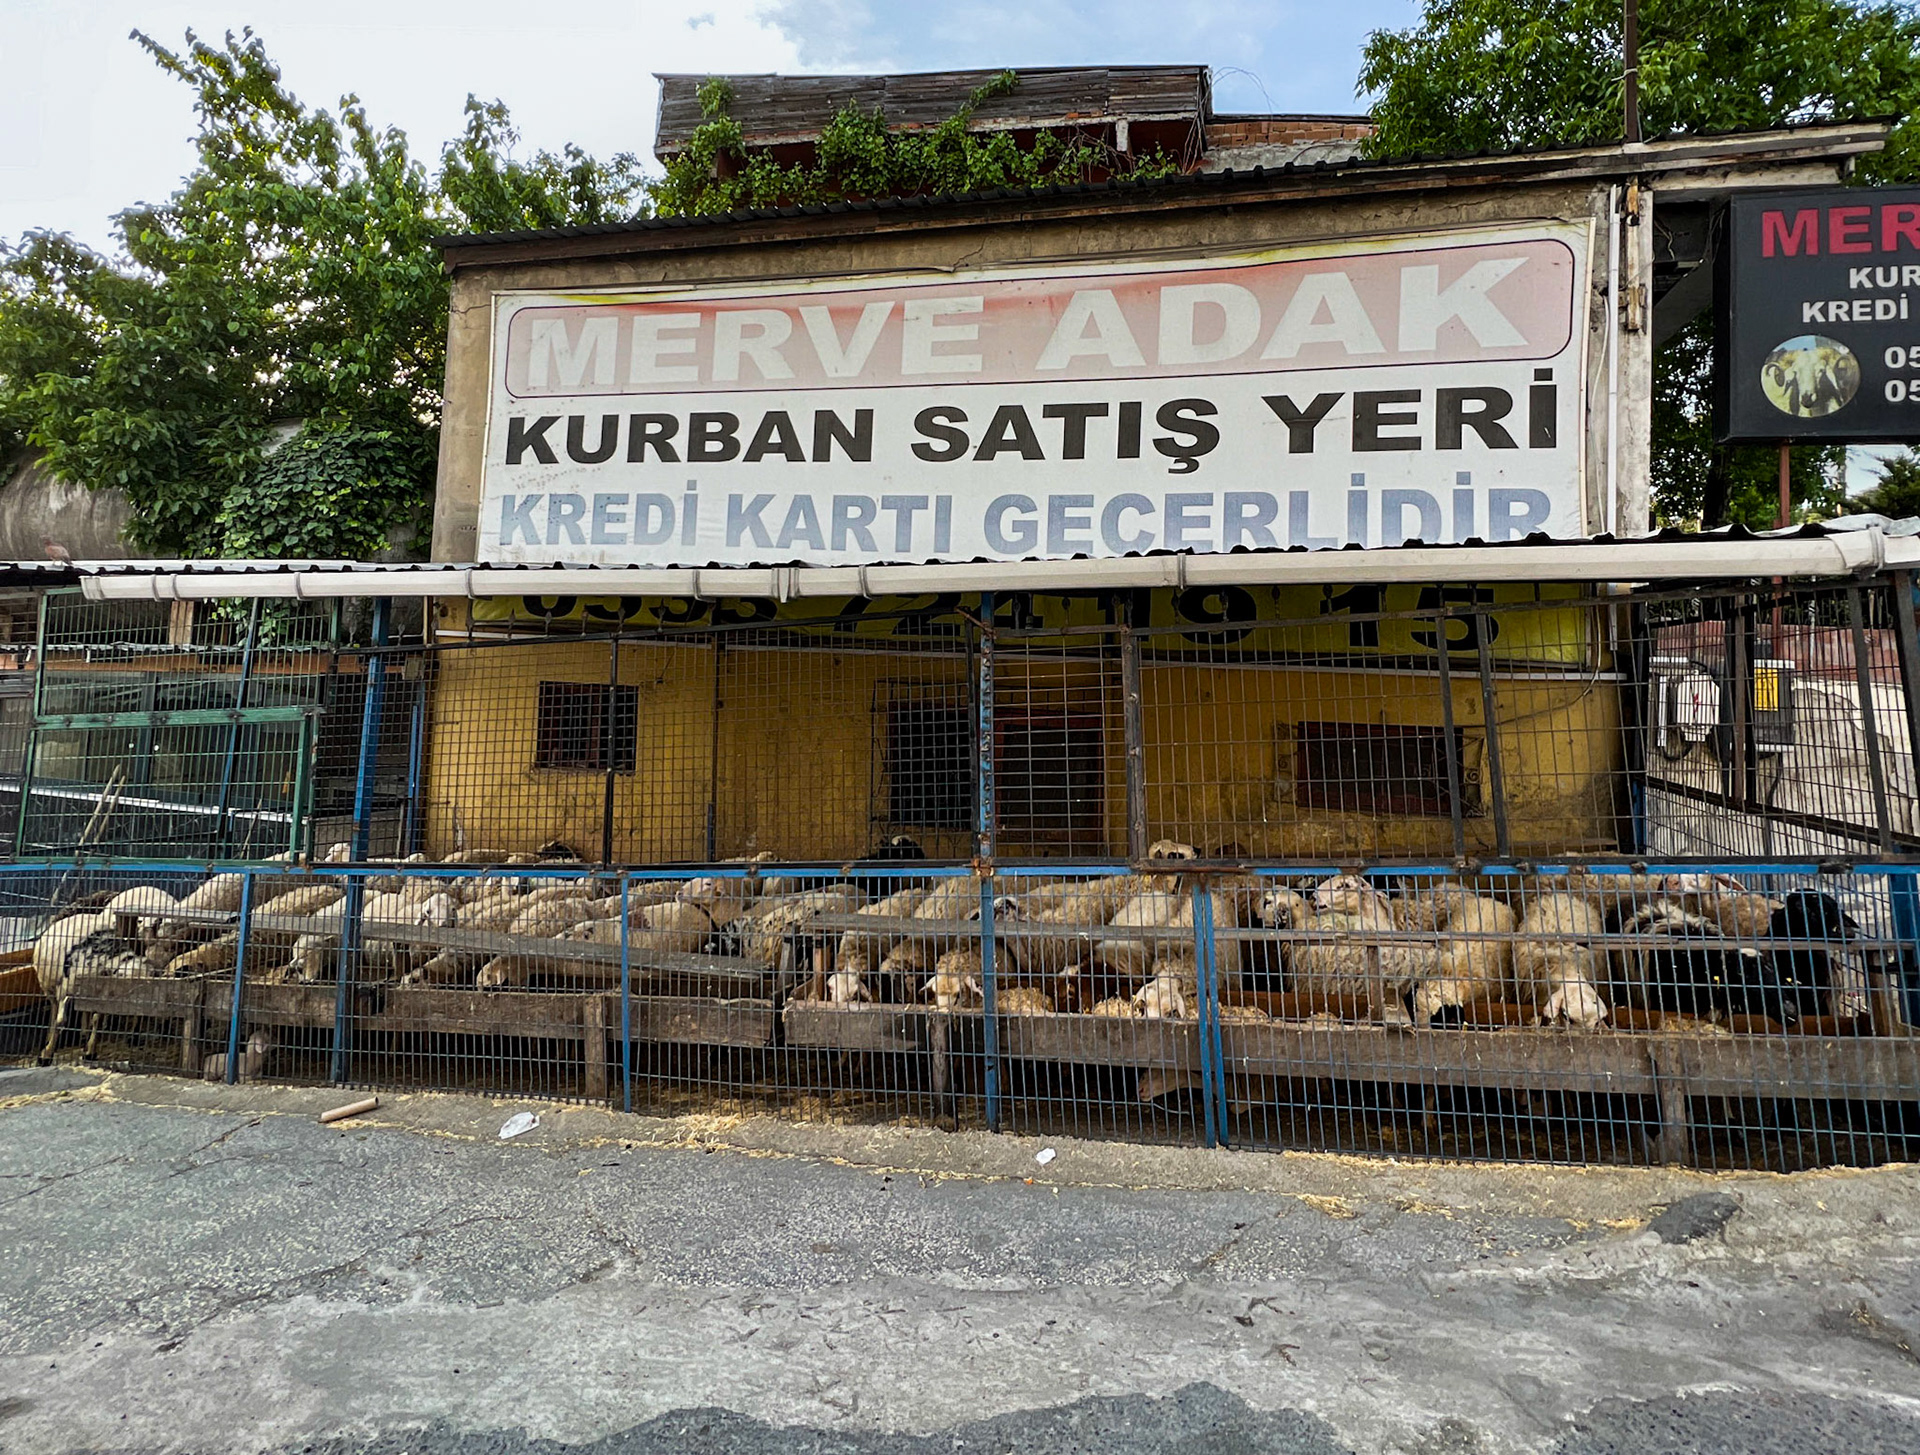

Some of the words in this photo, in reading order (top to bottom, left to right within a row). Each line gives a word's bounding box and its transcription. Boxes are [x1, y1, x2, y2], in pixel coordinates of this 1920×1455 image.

[1762, 203, 1920, 257] MER
[1802, 293, 1908, 322] KREDİ
[1850, 265, 1920, 289] KUR
[526, 295, 984, 389] MERVE
[1035, 257, 1529, 371] ADAK
[505, 409, 874, 465] KURBAN
[910, 398, 1220, 474] SATIŞ
[1261, 368, 1558, 454] YERİ
[500, 479, 699, 547] KREDİ
[725, 494, 953, 554] KARTI
[1320, 584, 1498, 650] 15
